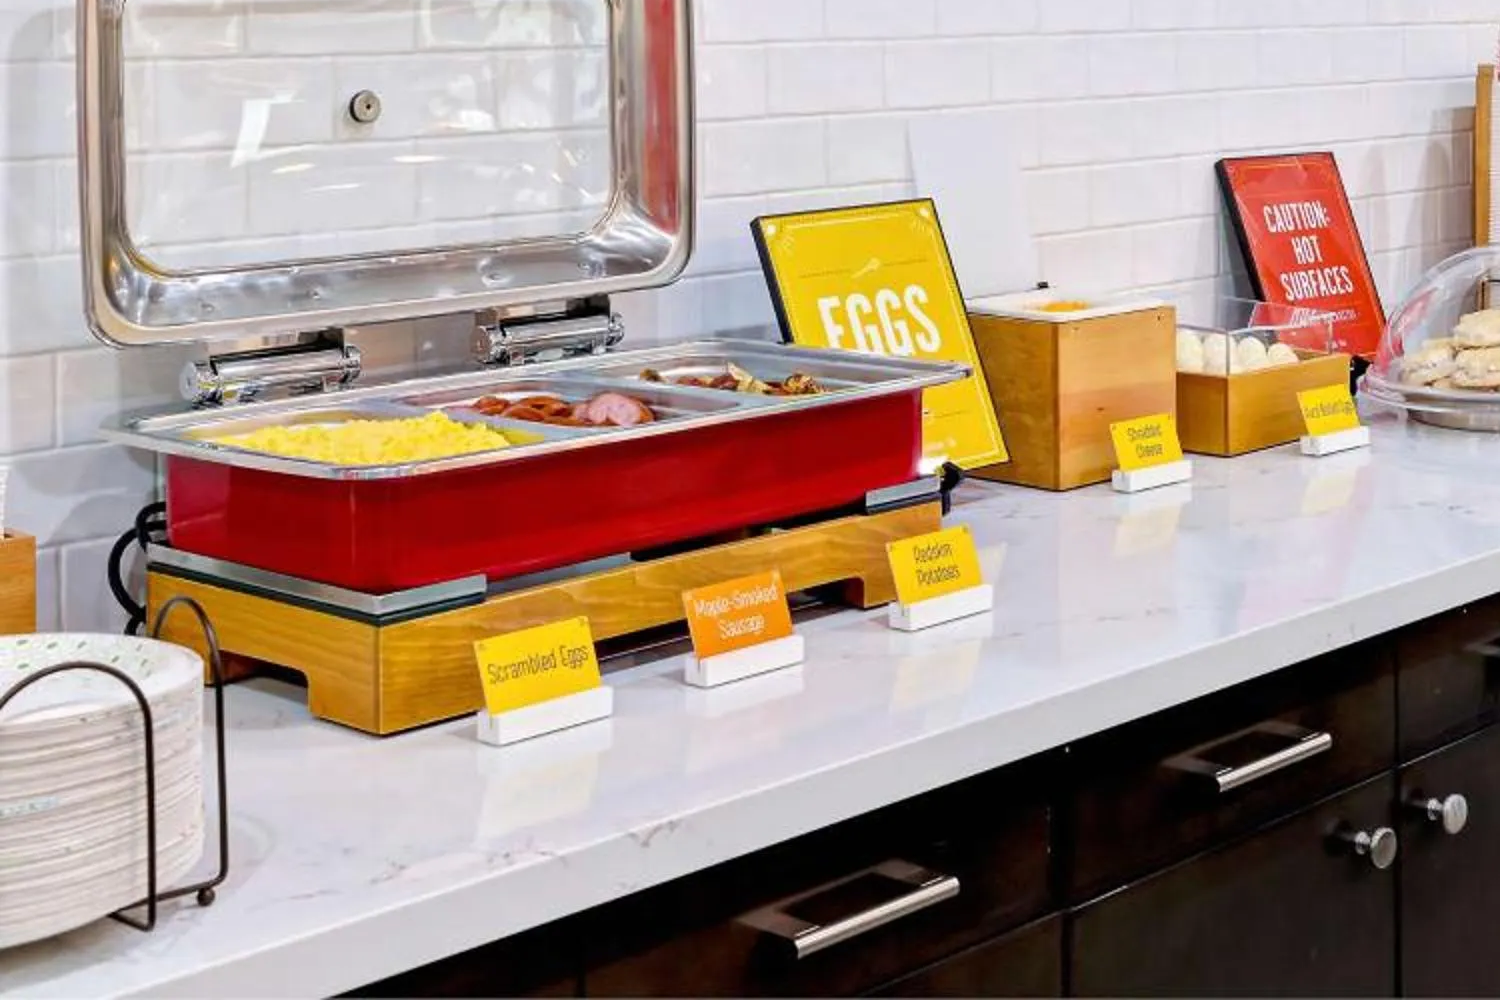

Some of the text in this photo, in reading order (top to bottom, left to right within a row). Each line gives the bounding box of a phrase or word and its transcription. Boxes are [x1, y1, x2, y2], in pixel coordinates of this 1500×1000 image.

[1263, 200, 1331, 233] CAUTION:
[1291, 235, 1324, 265] HOT
[1280, 265, 1353, 301] SURFACES
[817, 284, 942, 356] EGGS
[916, 565, 960, 586] Potatoes
[695, 585, 778, 617] Maple-Smoked
[719, 614, 765, 640] Sausage
[487, 645, 589, 685] Scrambled Eggs
